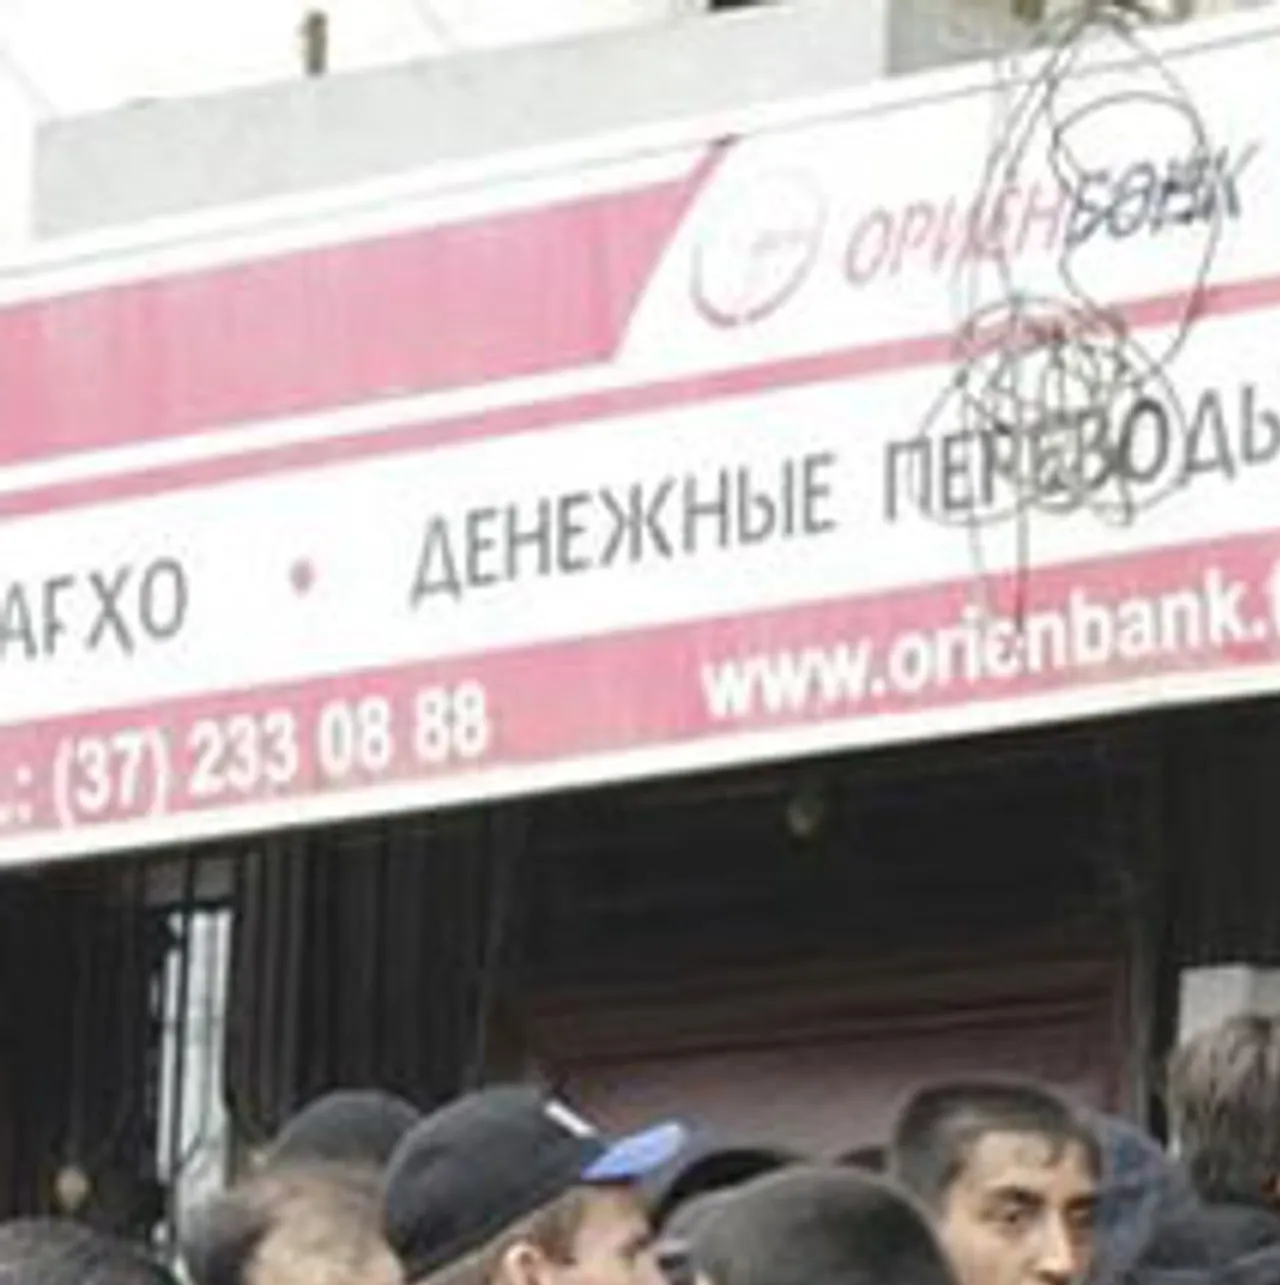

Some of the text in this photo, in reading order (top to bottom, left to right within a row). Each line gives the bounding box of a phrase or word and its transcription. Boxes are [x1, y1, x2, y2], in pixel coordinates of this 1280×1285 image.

[409, 450, 837, 609] ДЕНЕЖНЫЕ
[53, 725, 171, 832] (37)
[187, 707, 299, 796] 233
[316, 695, 394, 776] 08
[413, 678, 488, 765] 88
